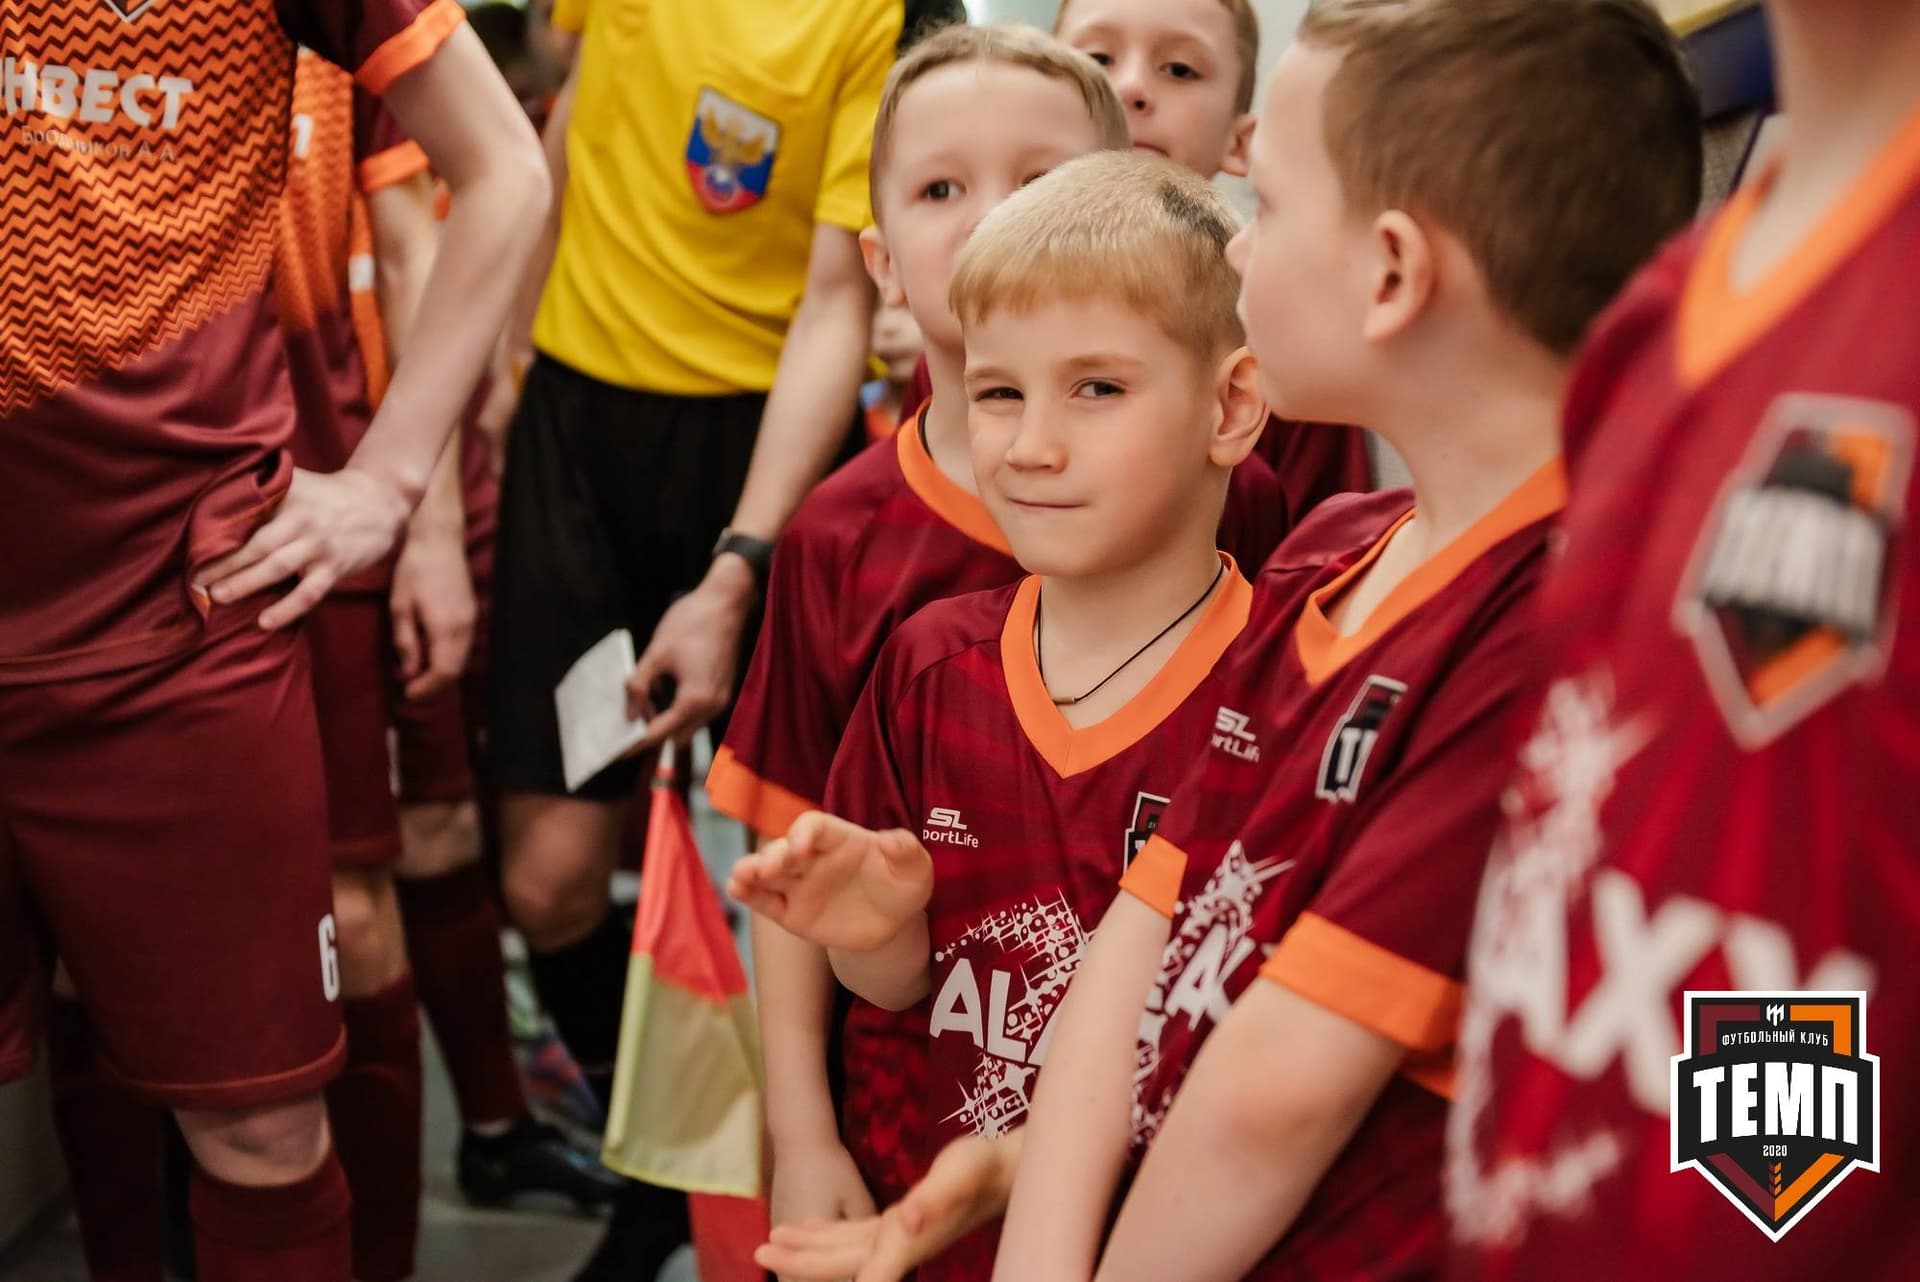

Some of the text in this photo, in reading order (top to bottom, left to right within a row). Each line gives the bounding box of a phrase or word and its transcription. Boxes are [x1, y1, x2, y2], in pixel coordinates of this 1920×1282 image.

[0, 56, 195, 129] НВЕСТ
[927, 807, 968, 830] SL
[318, 912, 340, 1002] 6
[929, 957, 1055, 1067] AL
